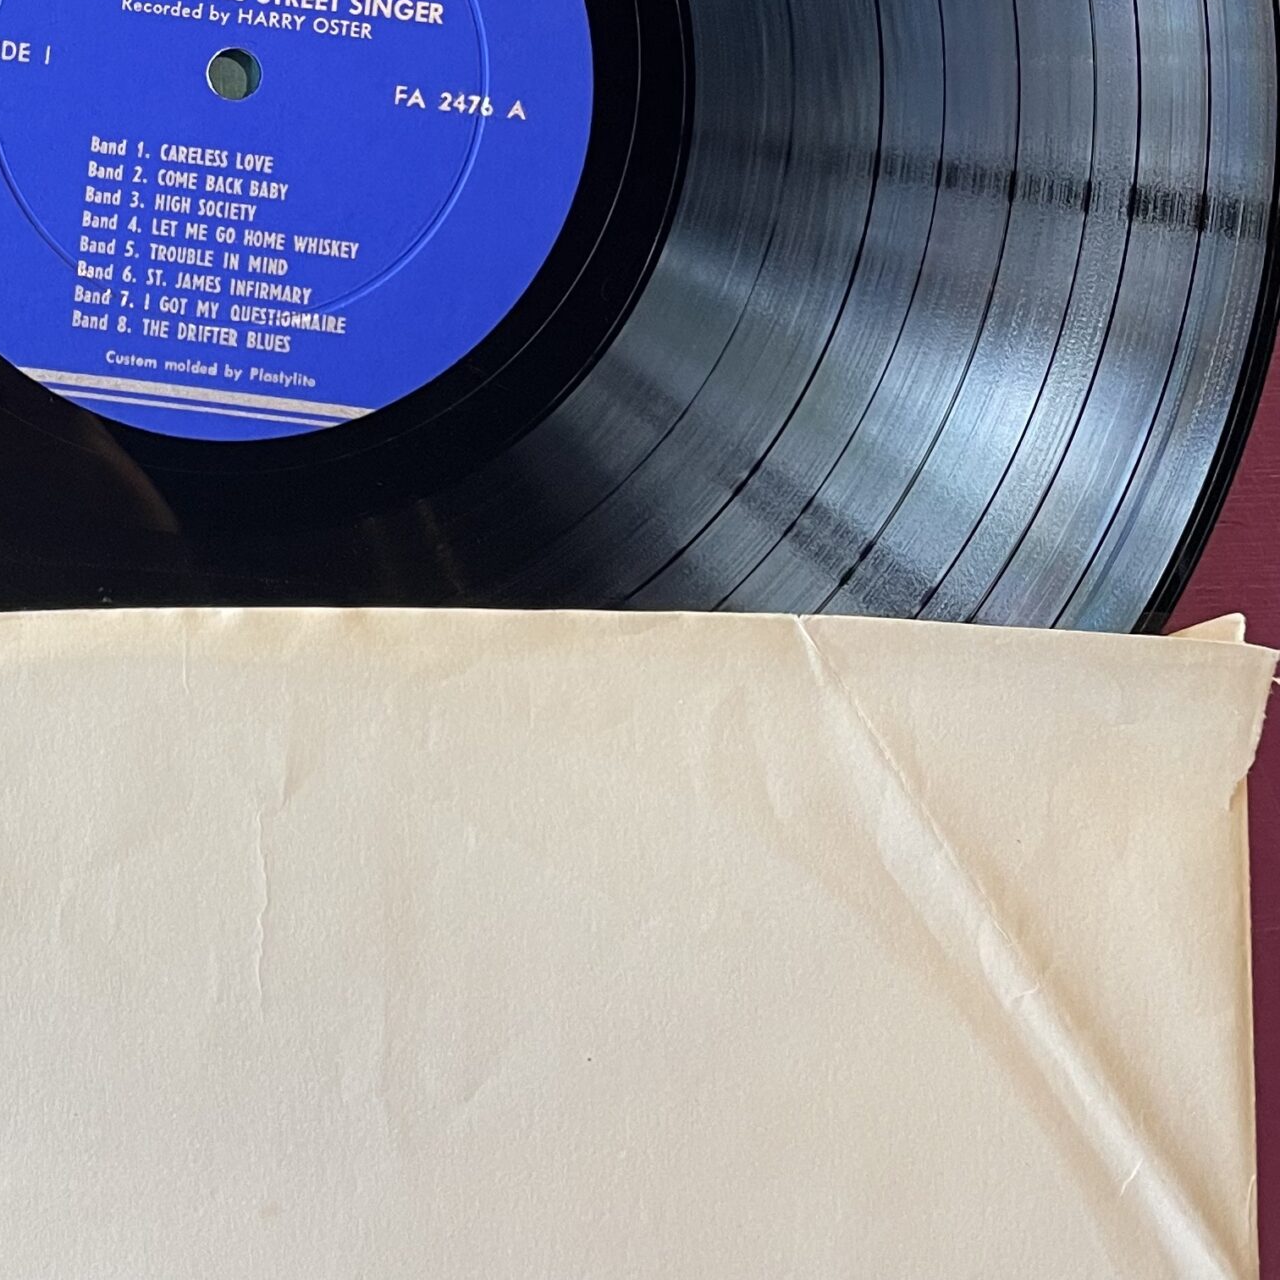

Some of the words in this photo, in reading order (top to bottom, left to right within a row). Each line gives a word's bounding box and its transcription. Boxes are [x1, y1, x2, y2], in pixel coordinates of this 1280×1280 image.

[209, 5, 230, 25] by
[238, 9, 306, 31] HARRY
[313, 18, 372, 39] OSTER
[395, 86, 426, 109] FA
[438, 92, 494, 117] 2476
[507, 101, 526, 120] A
[91, 136, 127, 156] Band
[138, 142, 149, 159] 1.
[160, 144, 228, 168] CARELESS
[236, 153, 273, 173] LOVE
[88, 161, 124, 181] Band
[133, 166, 147, 183] 2.
[158, 169, 198, 189] COME
[206, 175, 243, 195] BACK
[250, 180, 288, 200] BABY
[86, 186, 122, 205] Band
[130, 191, 144, 208] 3.
[155, 194, 191, 214] HIGH
[198, 199, 257, 221] SOCIETY
[82, 211, 118, 230] Band
[128, 216, 141, 233] 4.
[152, 218, 178, 237] LET
[186, 223, 208, 241] ME
[216, 227, 236, 244] GO
[244, 230, 285, 250] HOME
[294, 236, 359, 259] WHISKEY
[80, 236, 116, 255] Band
[125, 241, 139, 258] 5.
[150, 243, 214, 267] TROUBLE
[223, 252, 239, 270] IN
[249, 255, 288, 276] MIND
[78, 260, 114, 280] Band
[123, 266, 136, 282] 6.
[146, 269, 166, 286] ST.
[176, 272, 221, 293] JAMES
[231, 279, 312, 305] INFIRMARY
[75, 285, 112, 305] Band
[121, 291, 134, 308] 7.
[144, 294, 150, 310] I
[160, 296, 188, 315] GOT
[197, 300, 219, 319] MY
[231, 305, 346, 334] QUESTIONNAIRE
[72, 310, 108, 330] Band
[117, 316, 131, 333] 8.
[143, 319, 169, 338] THE
[178, 323, 238, 347] DRIFTER
[247, 331, 291, 353] BLUES
[106, 351, 157, 368] Custom
[165, 360, 218, 376] molded
[225, 364, 243, 381] by
[250, 368, 315, 387] Plastylite
